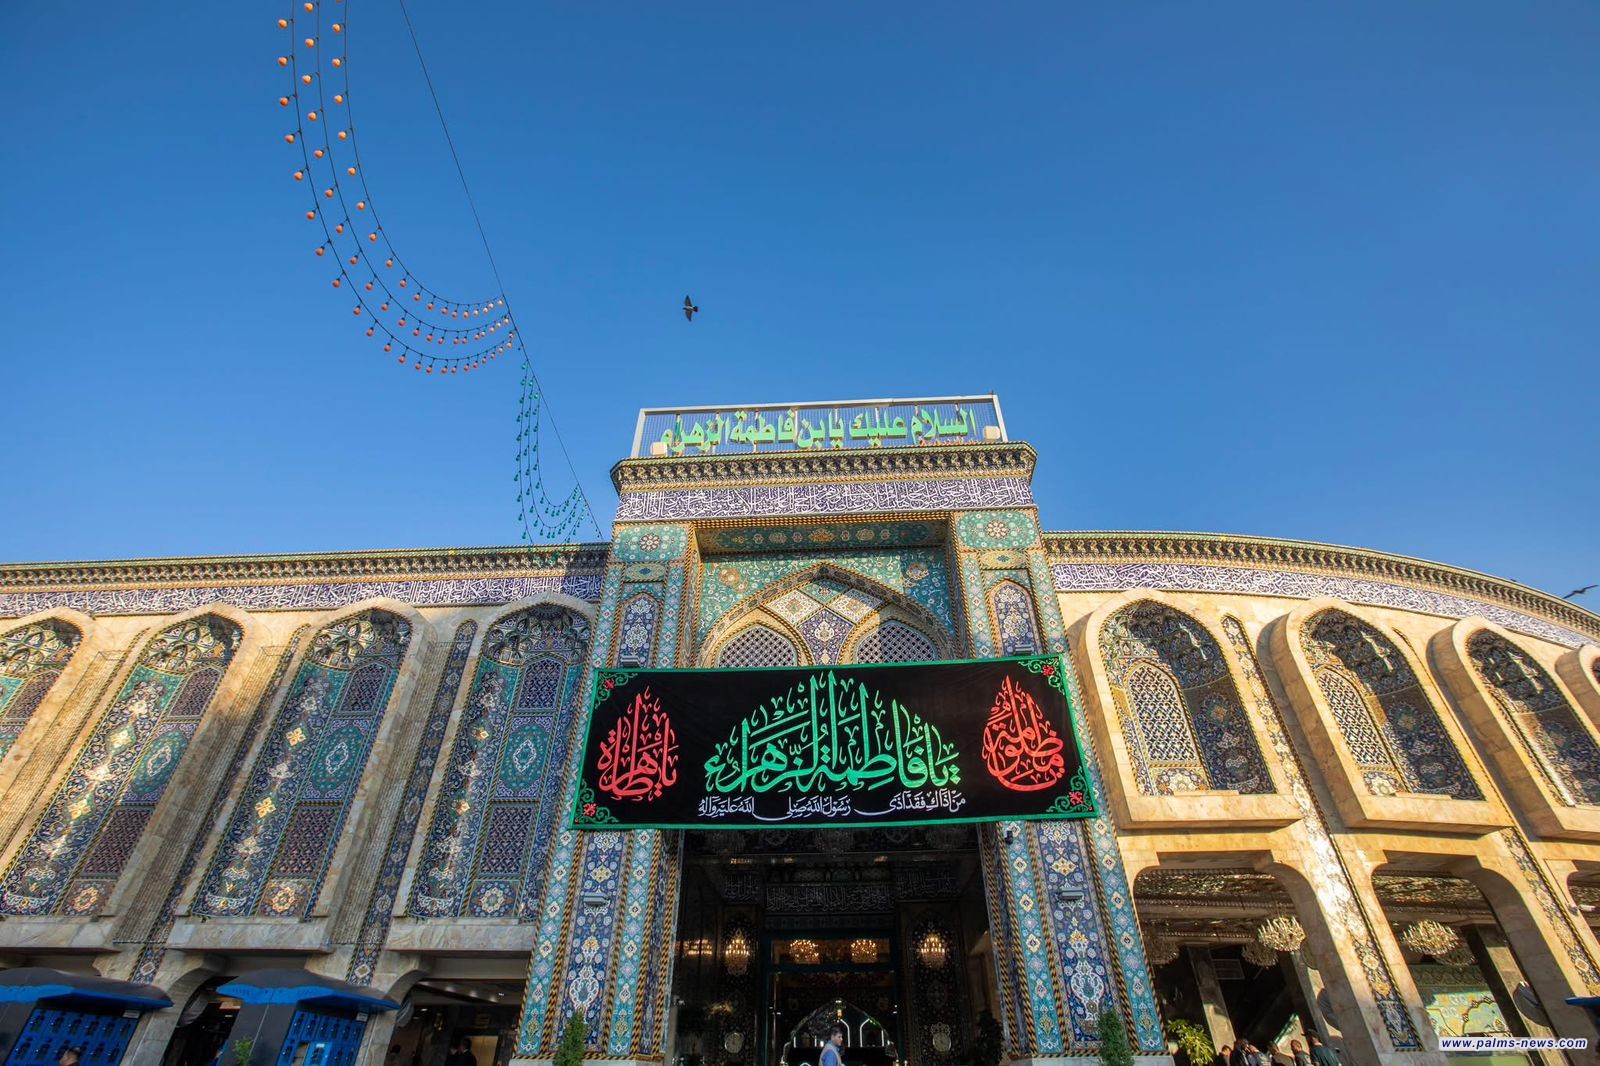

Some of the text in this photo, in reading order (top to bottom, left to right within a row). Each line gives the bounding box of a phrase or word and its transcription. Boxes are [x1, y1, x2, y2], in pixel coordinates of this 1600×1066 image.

[730, 408, 794, 444] فاطمة
[850, 408, 907, 448] عليك
[911, 407, 977, 446] السلام
